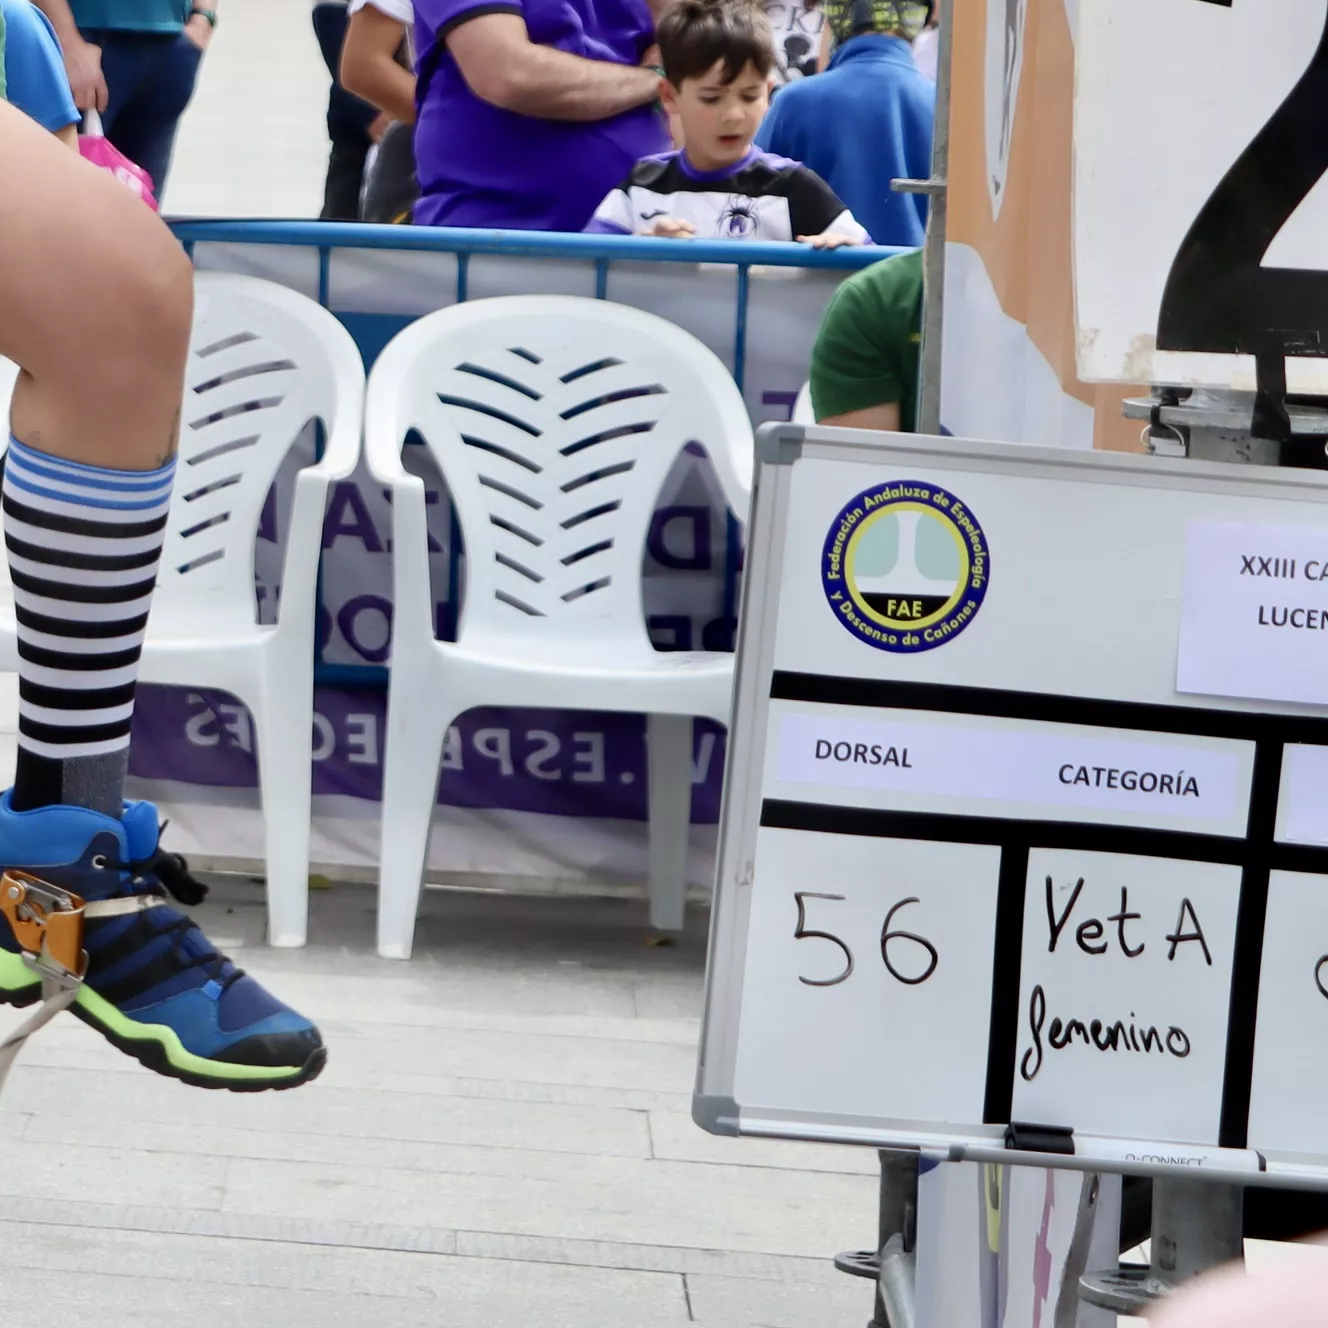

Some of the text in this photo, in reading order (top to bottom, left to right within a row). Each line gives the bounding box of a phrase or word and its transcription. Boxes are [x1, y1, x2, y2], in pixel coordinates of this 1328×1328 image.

[828, 484, 986, 588] Federación Andaluza de Espeleología
[1240, 554, 1295, 579] XXIII
[831, 590, 976, 645] y Descenso de Cañones
[887, 600, 922, 617] FAE
[815, 739, 912, 768] DORSAL
[1058, 763, 1200, 797] CATEGORÍA
[794, 891, 938, 985] 56
[1046, 875, 1212, 966] Vet A
